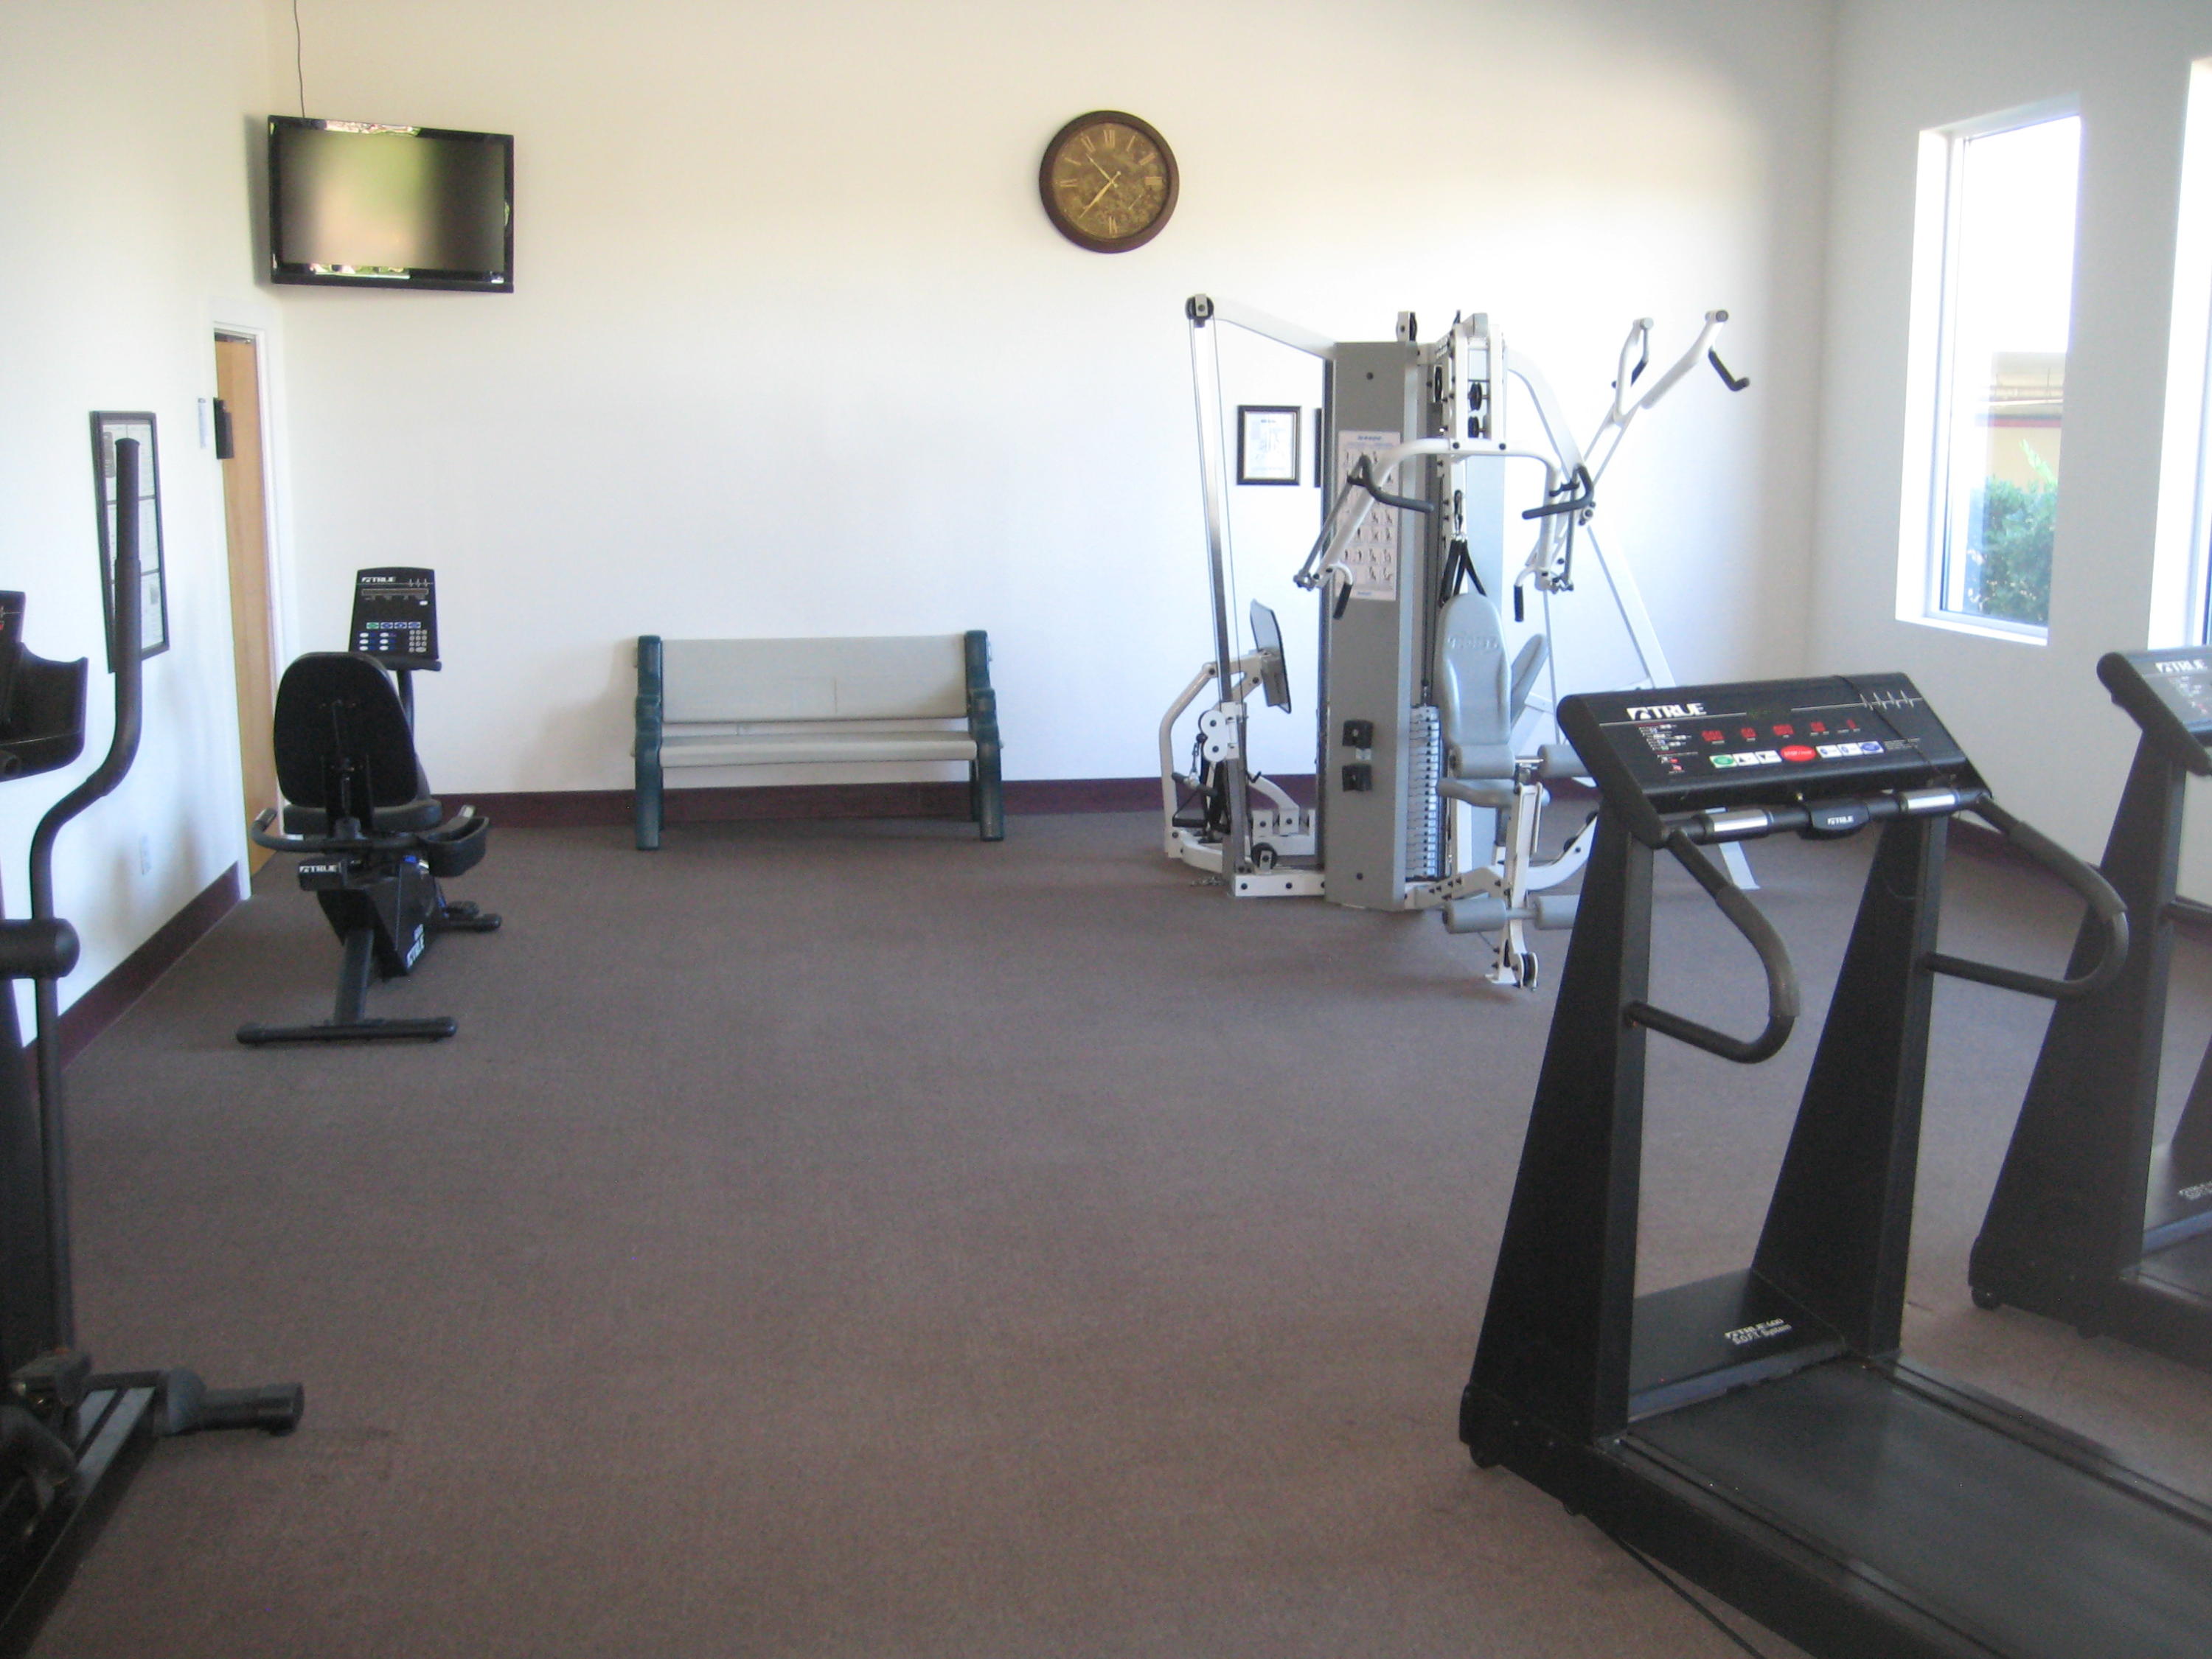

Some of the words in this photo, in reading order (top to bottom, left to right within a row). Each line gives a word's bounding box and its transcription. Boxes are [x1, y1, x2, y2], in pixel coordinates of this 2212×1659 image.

[1646, 703, 1707, 720] TRUE
[1833, 815, 1854, 825] TRUE
[310, 865, 337, 873] TRUE
